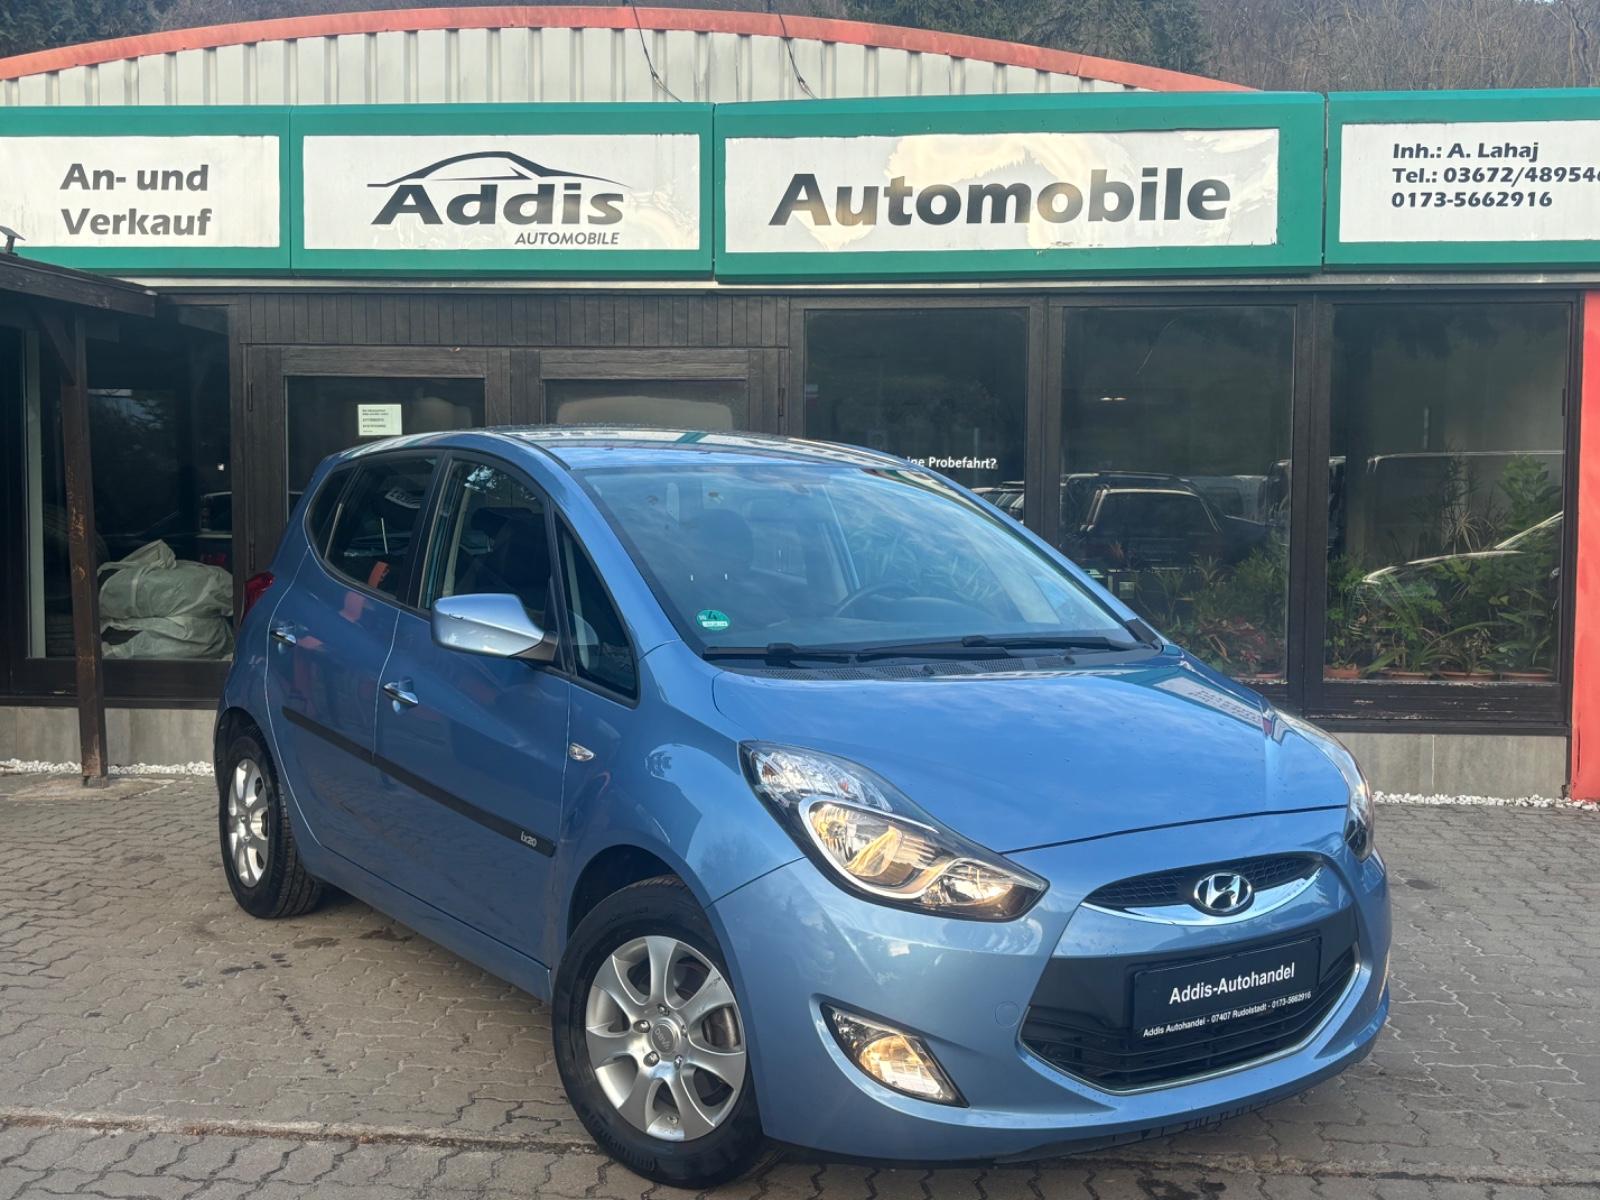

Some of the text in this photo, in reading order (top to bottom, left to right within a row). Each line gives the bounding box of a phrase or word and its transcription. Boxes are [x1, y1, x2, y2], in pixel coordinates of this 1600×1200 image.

[1393, 142, 1539, 163] Inh.: A. Lahaj
[59, 163, 209, 192] An- und
[1392, 168, 1438, 184] Tel.:
[370, 182, 624, 226] Addis
[768, 167, 1231, 226] Automobile
[1391, 191, 1553, 208] 0173-5662916
[60, 208, 213, 236] Verkauf
[514, 232, 620, 246] AUTOMOBILE
[928, 456, 997, 469] Probefahrt?
[1169, 962, 1295, 1005] Addis-Autohandel
[1143, 1025, 1165, 1038] Addis
[1165, 1018, 1206, 1033] Autohandel
[1210, 1011, 1232, 1024] 07407
[1232, 1004, 1267, 1019] Rudolstadt
